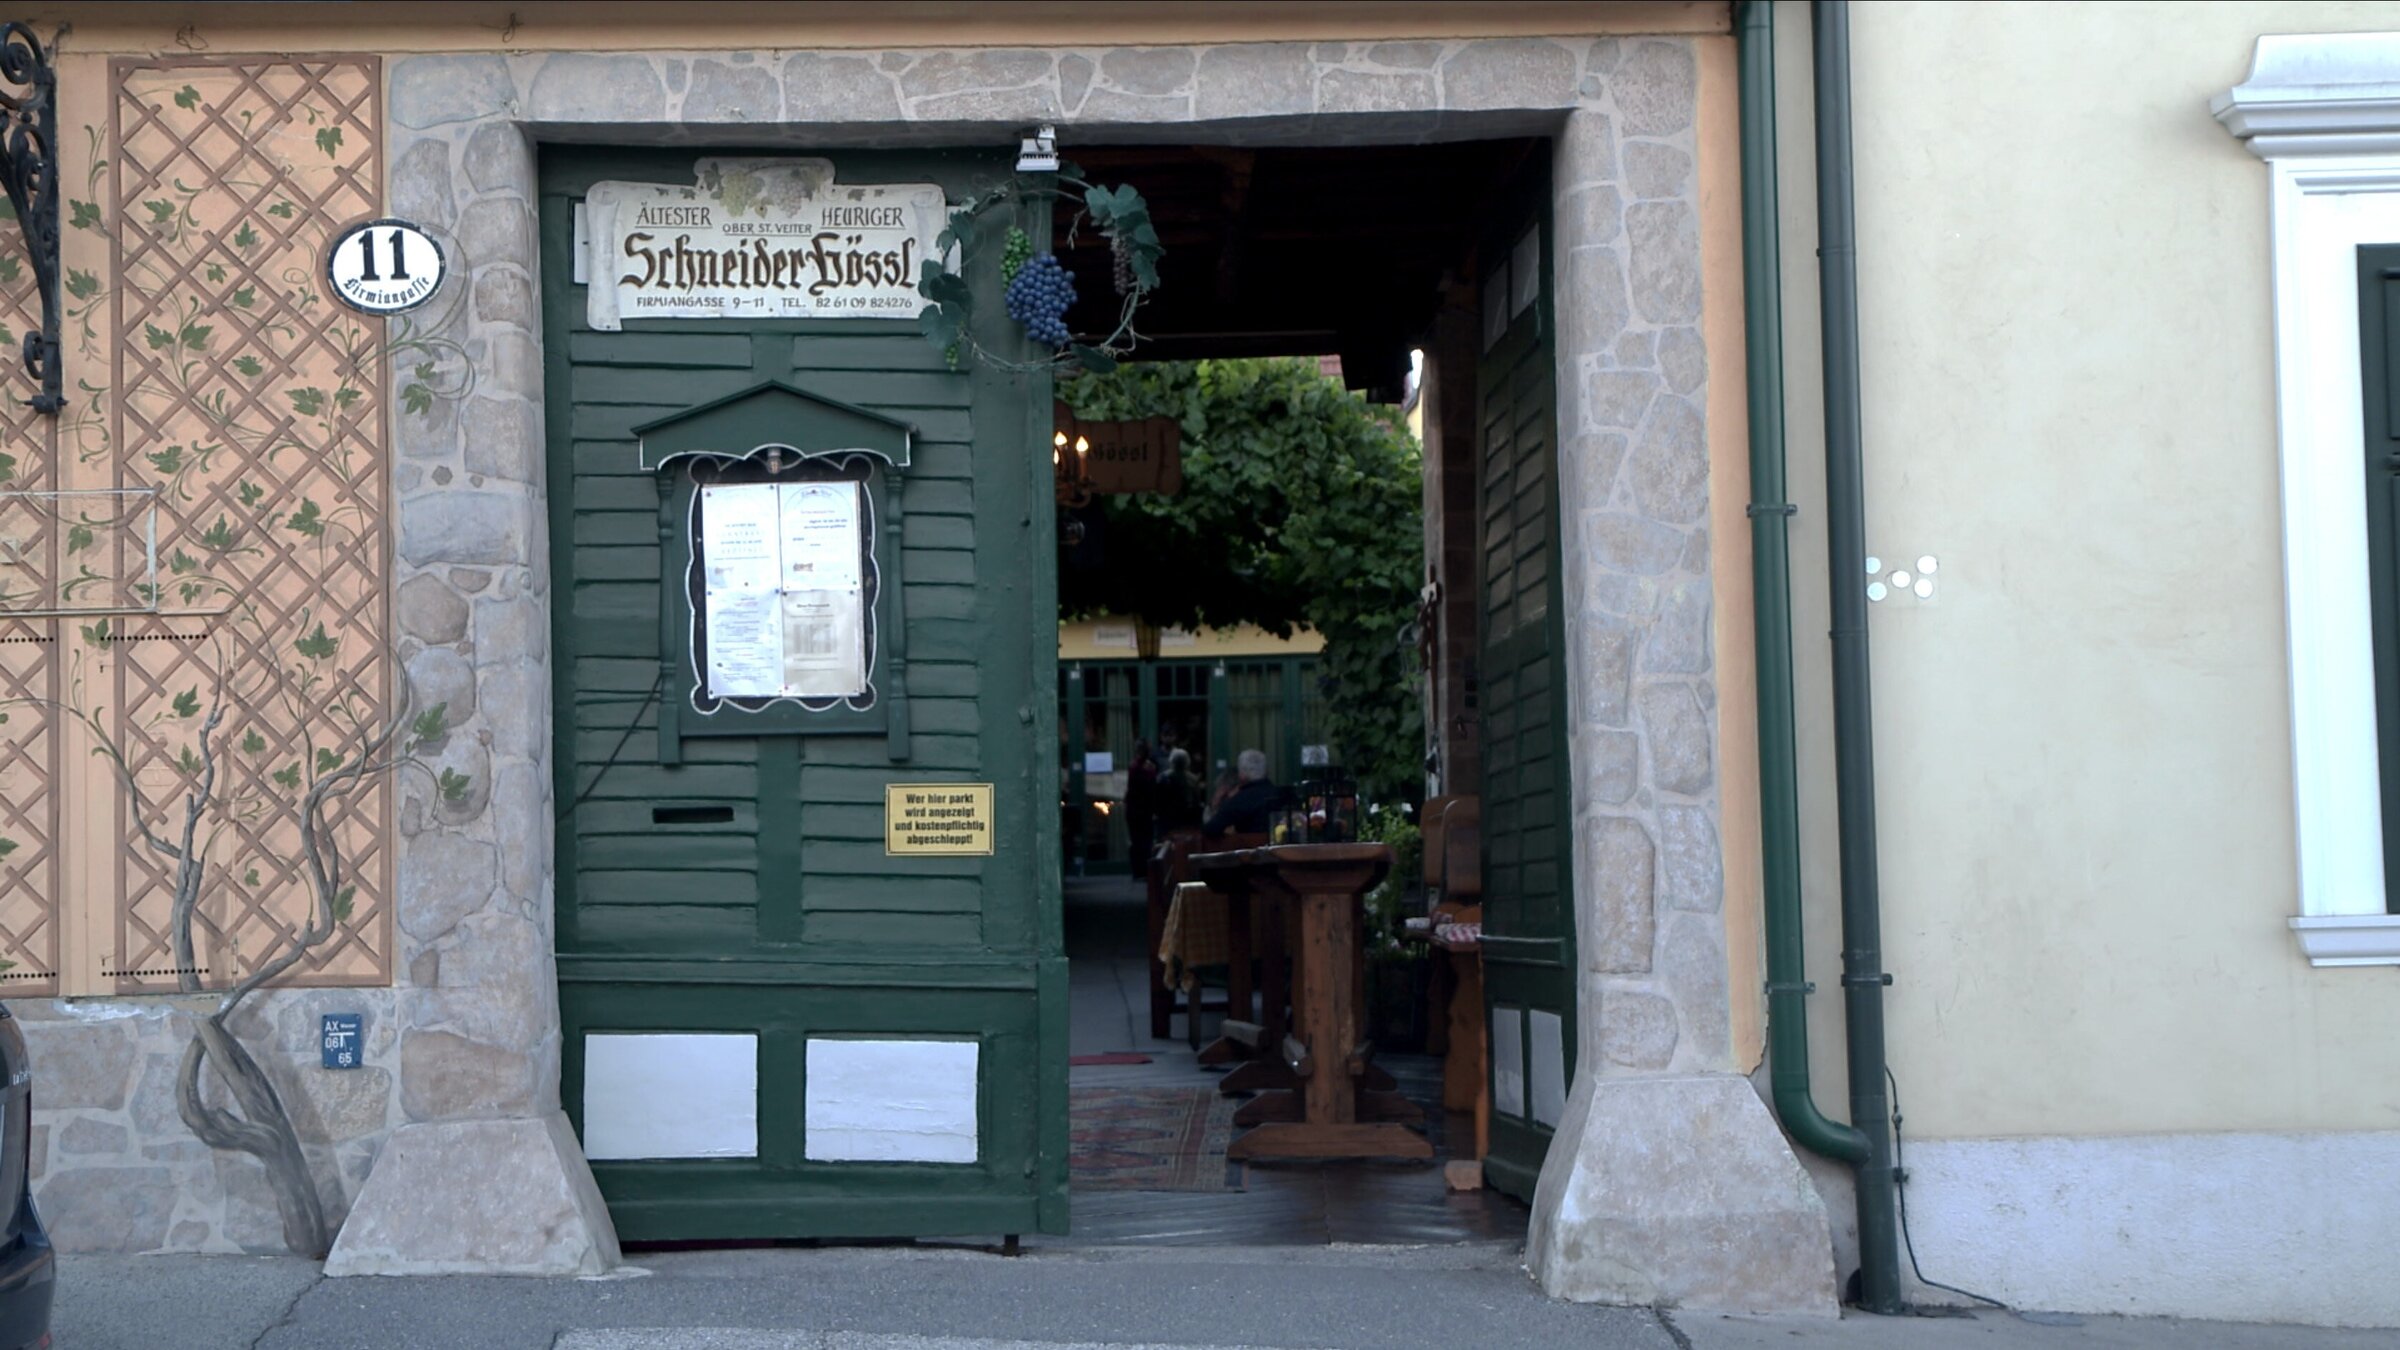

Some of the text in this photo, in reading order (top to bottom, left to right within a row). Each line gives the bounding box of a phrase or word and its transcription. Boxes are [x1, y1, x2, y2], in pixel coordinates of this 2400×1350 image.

[635, 201, 712, 227] ÄLTESTER
[821, 206, 905, 228] HEURIGER
[722, 223, 755, 234] OBER
[758, 223, 774, 234] ST.
[358, 229, 410, 281] 11
[636, 296, 725, 308] FIRMIANGASSE
[781, 297, 807, 308] TEL.
[816, 297, 831, 308] 82
[833, 297, 847, 308] 61
[906, 794, 974, 805] Wer hier parkt
[905, 808, 975, 818] wird angezeigt
[894, 821, 985, 832] und kostenpflichtig
[906, 834, 973, 846] abgeschleppt!
[325, 1021, 339, 1031] AX
[325, 1037, 339, 1048] 06
[338, 1052, 352, 1064] 65
